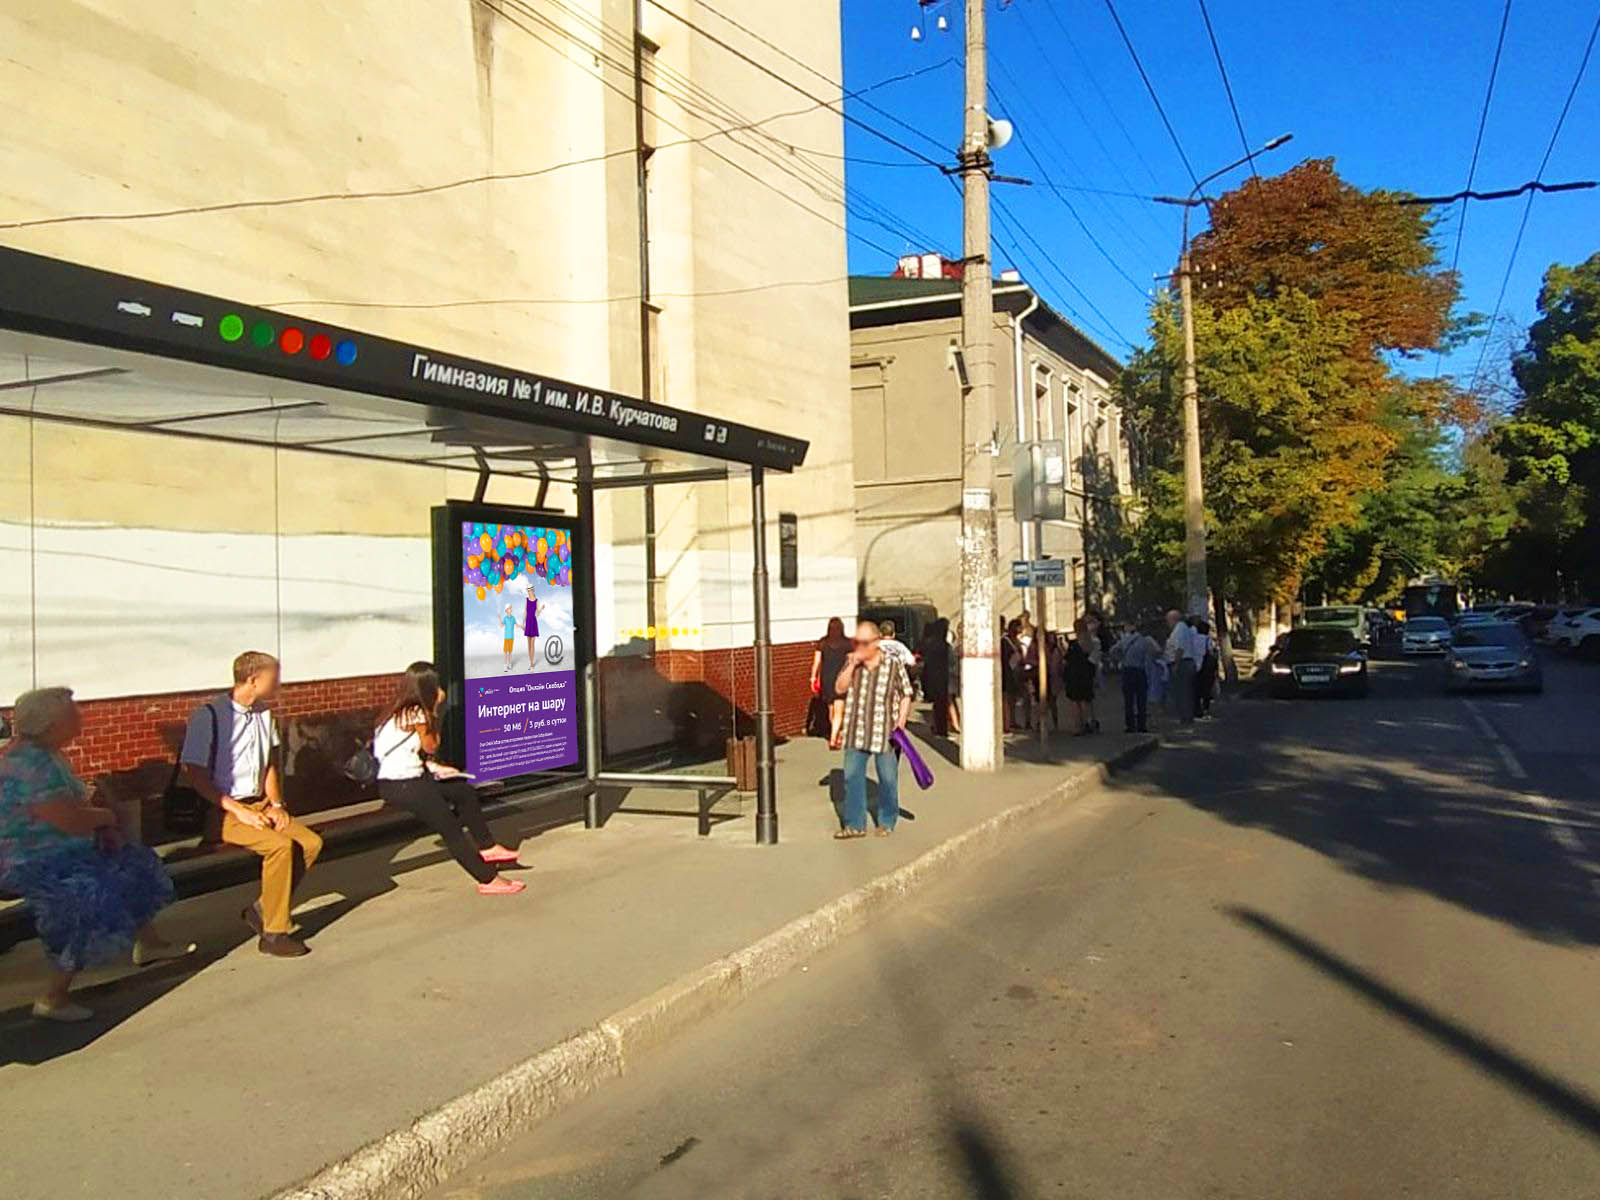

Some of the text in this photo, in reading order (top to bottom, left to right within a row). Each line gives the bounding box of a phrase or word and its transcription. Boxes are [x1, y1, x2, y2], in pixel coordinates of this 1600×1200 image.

[412, 354, 678, 432] Гимназия №1 им. И.В. Курчатова
[544, 634, 564, 665] @
[478, 698, 566, 718] Интернет на шару
[504, 723, 511, 732] 50
[551, 718, 567, 727] сутки
